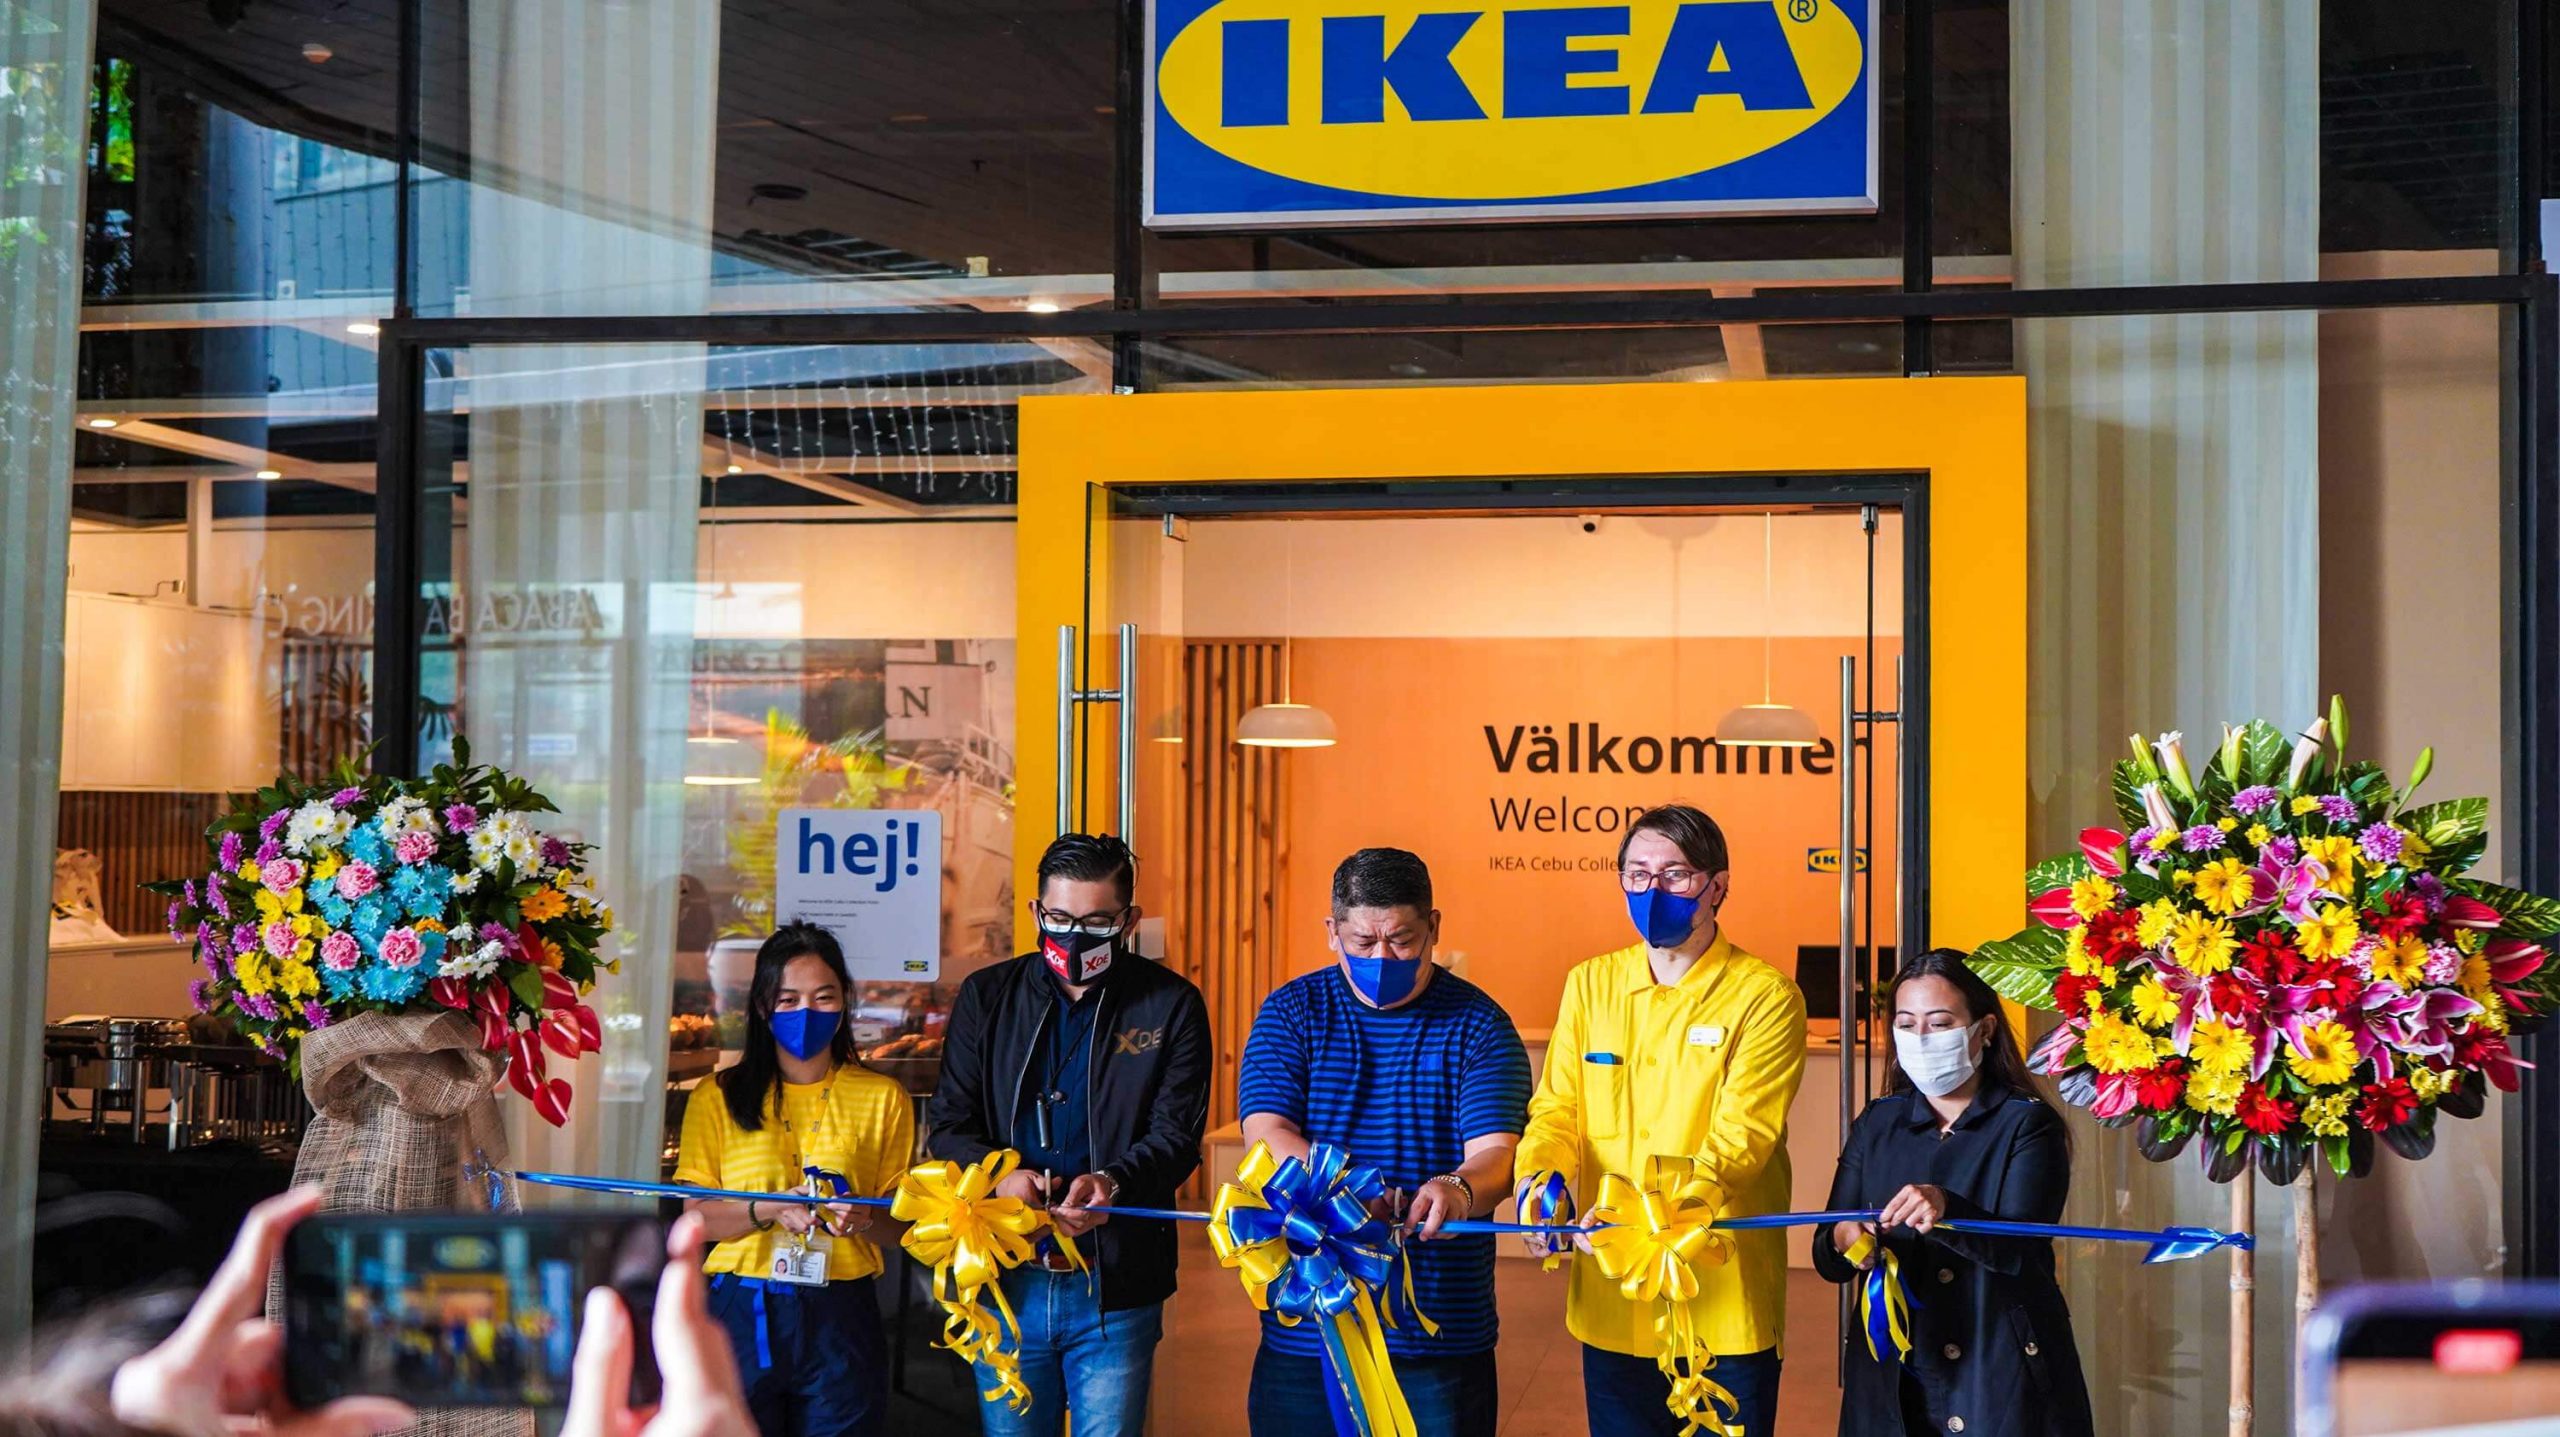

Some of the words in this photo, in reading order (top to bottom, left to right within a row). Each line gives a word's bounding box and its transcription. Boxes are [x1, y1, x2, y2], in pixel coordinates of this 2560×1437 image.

[1221, 1, 1815, 127] IKEA
[886, 686, 932, 718] N
[1490, 796, 1645, 832] Welco
[798, 818, 919, 892] hej!
[1489, 857, 1526, 871] IKEA
[1531, 856, 1573, 871] Cebu
[1578, 857, 1619, 872] Colle
[1814, 855, 1865, 865] IKA
[1085, 953, 1110, 972] XDE
[1114, 1027, 1163, 1055] XDE
